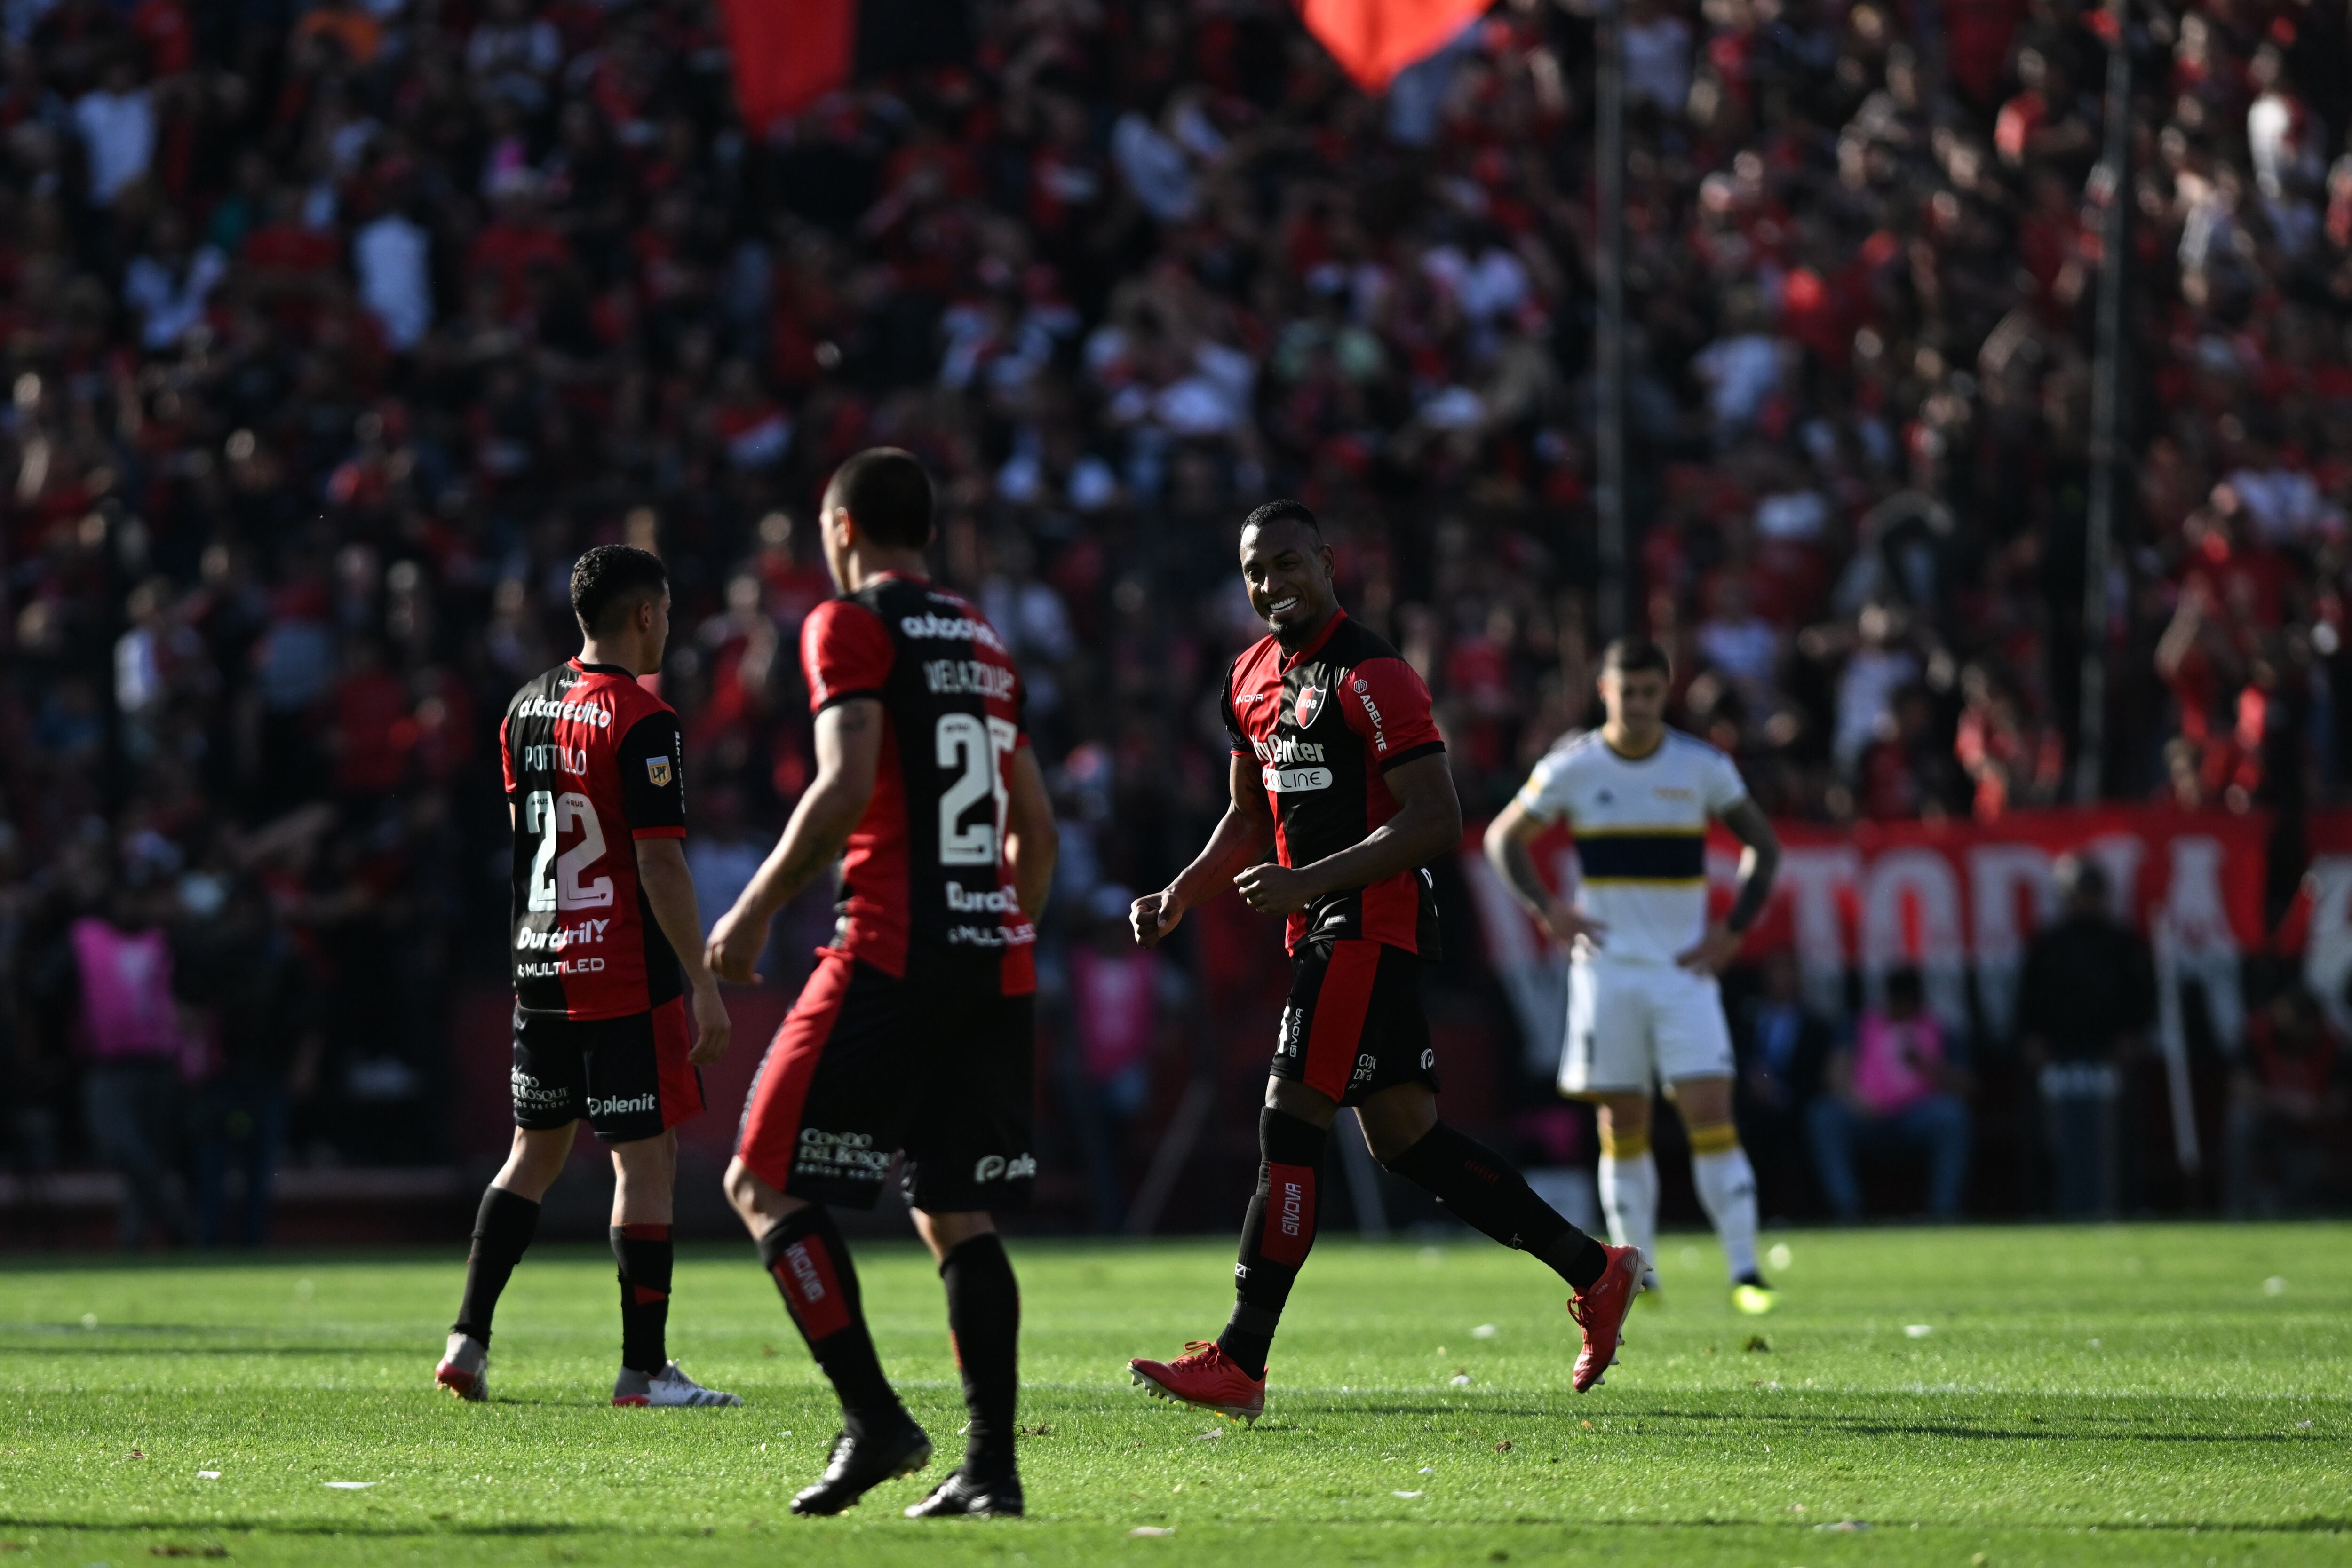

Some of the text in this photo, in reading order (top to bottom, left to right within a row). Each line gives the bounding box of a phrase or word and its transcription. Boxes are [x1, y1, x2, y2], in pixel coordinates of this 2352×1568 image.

[1300, 699, 1317, 709] NOB
[1360, 695, 1387, 752] ADELTE
[526, 790, 614, 911] 22
[1289, 1008, 1303, 1058] GIVOVA
[603, 1093, 655, 1116] plenit
[1281, 1182, 1302, 1236] GIVOVA
